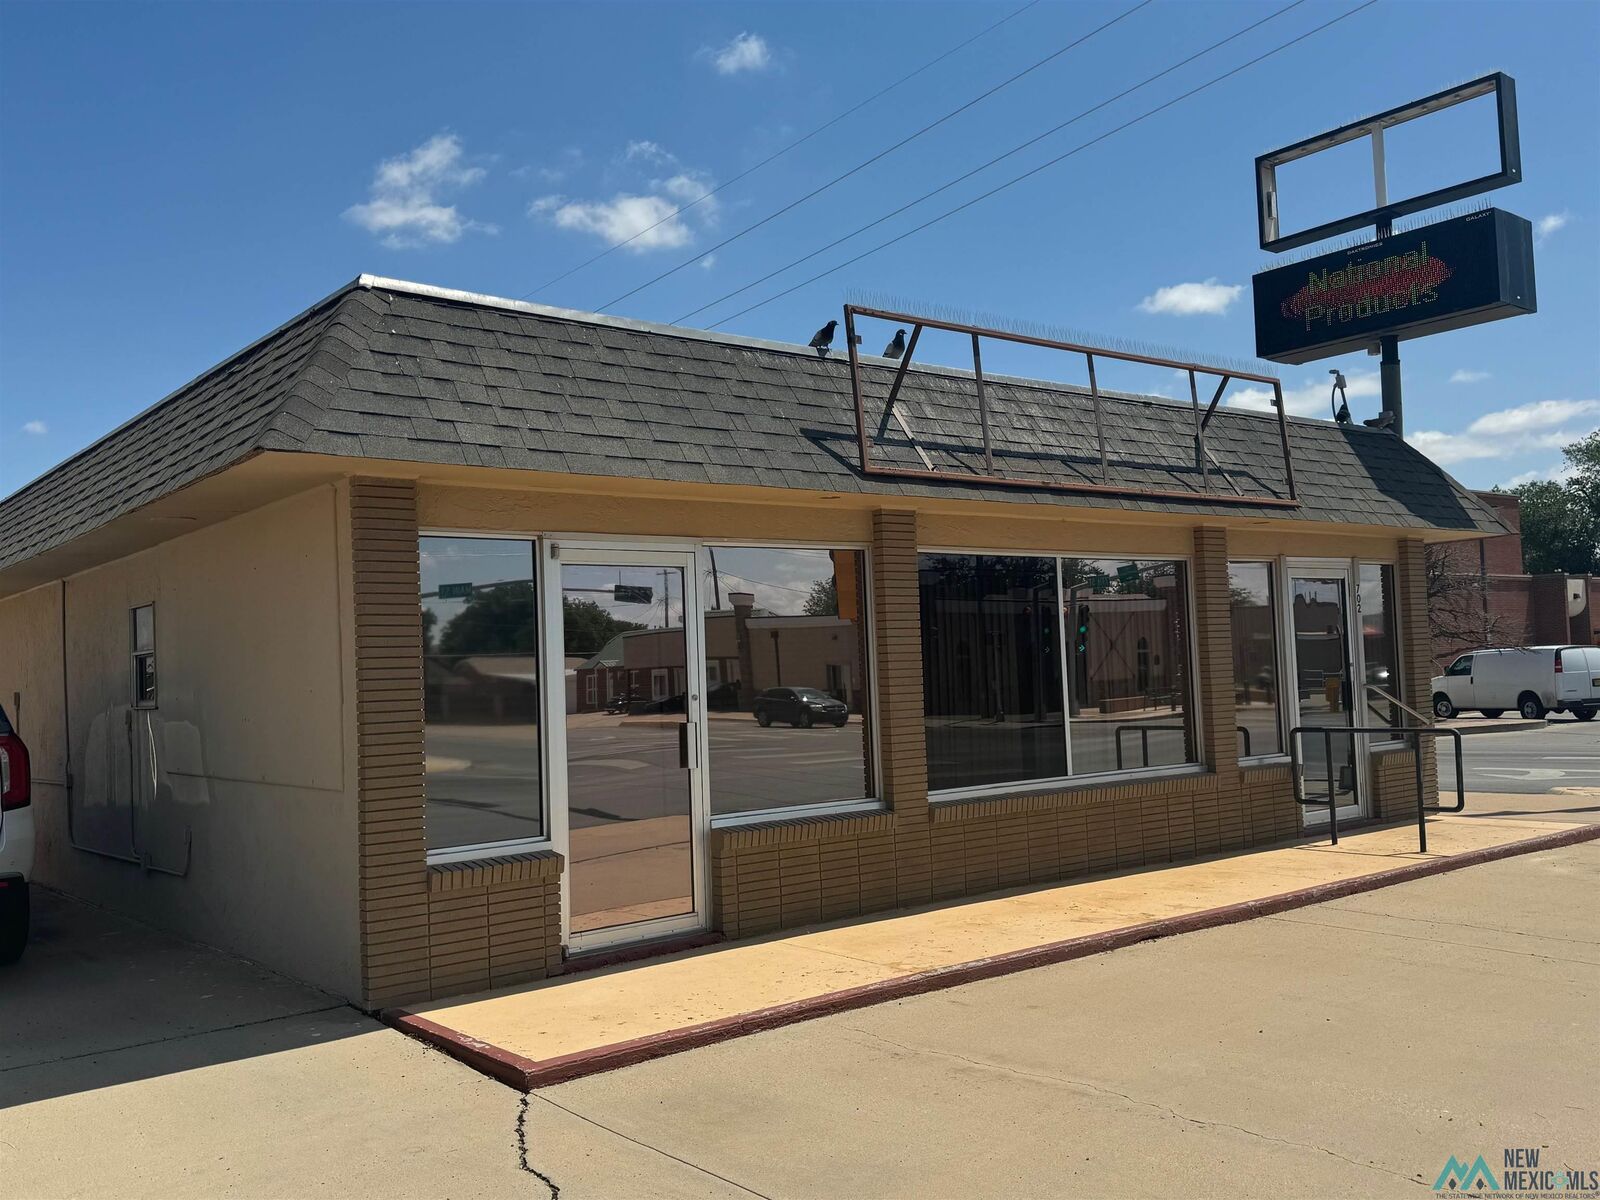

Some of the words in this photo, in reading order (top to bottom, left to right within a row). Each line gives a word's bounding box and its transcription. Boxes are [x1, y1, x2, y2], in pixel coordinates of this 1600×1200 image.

[1465, 211, 1490, 222] GALAXY
[1308, 240, 1427, 295] National
[1305, 282, 1439, 332] Products
